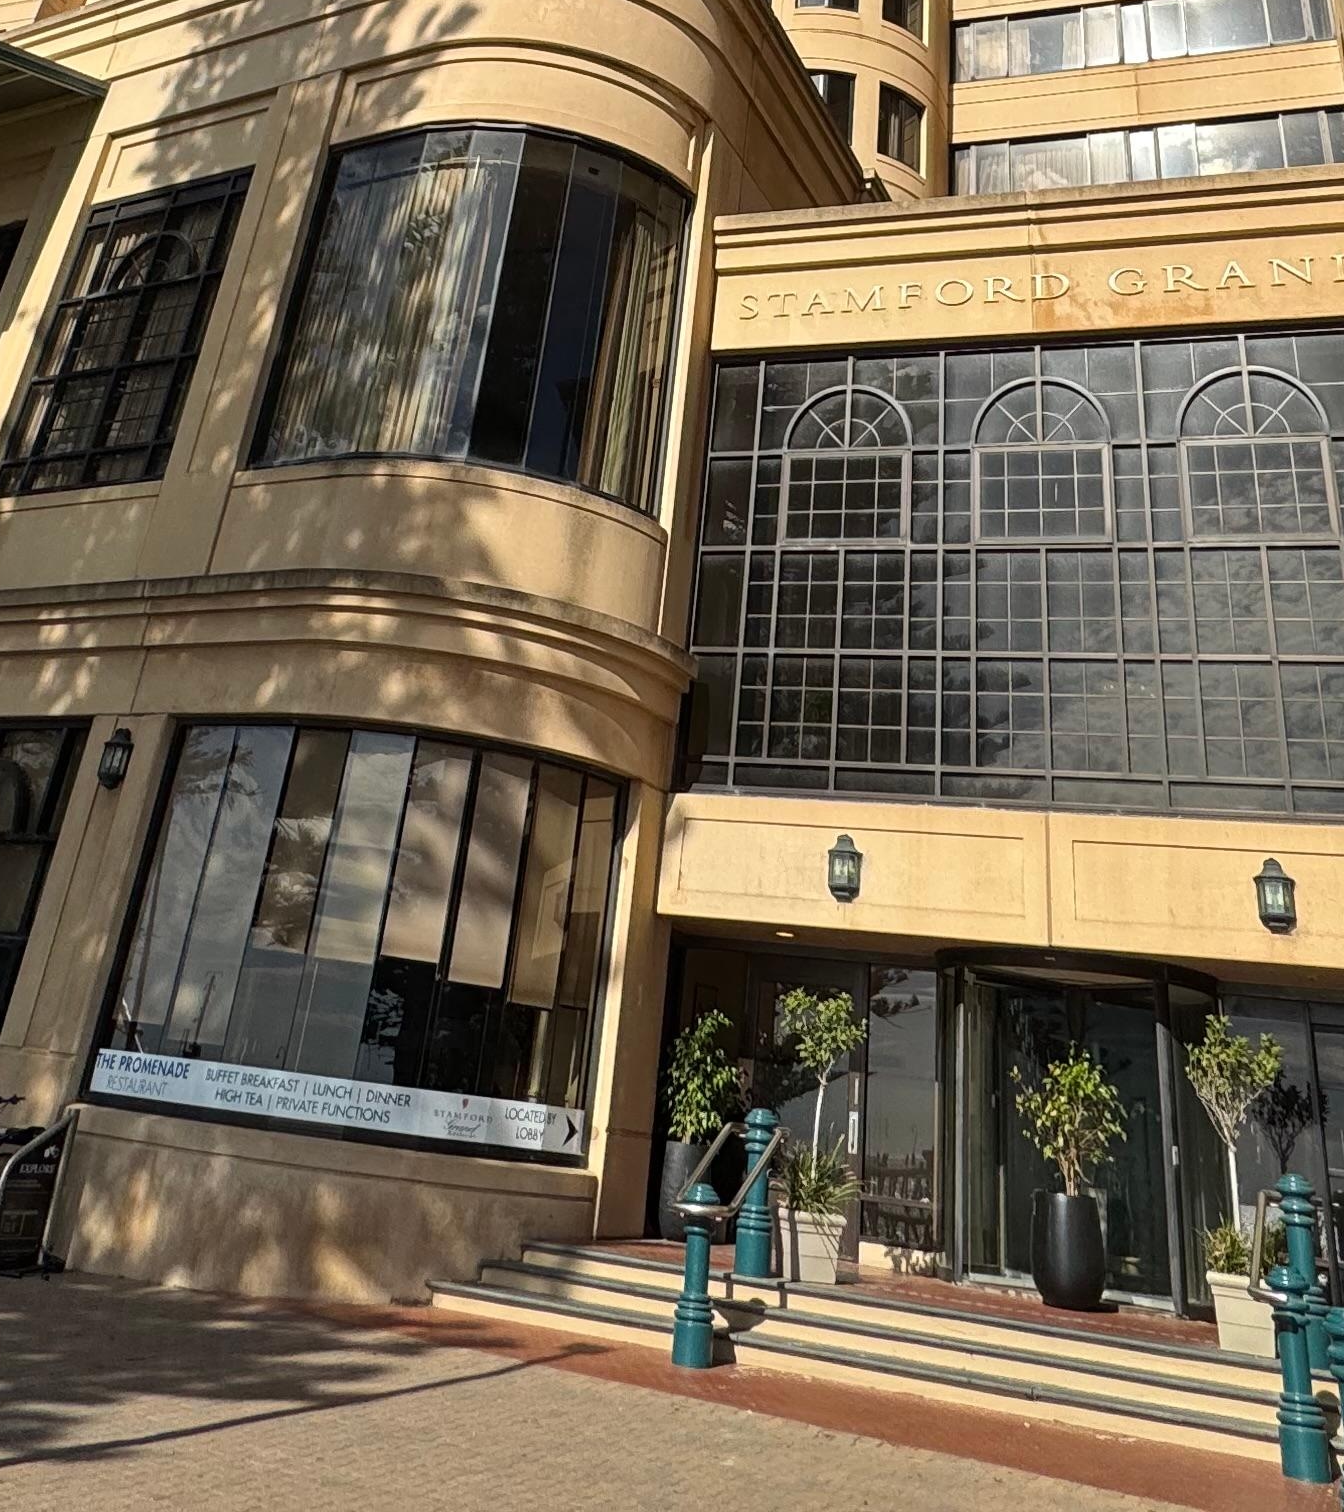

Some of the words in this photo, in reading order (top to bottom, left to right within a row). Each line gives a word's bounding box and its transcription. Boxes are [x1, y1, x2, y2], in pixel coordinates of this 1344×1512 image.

[738, 271, 1071, 321] STAMFORD
[96, 1052, 115, 1070] THE
[119, 1055, 191, 1080] PROMENADE
[106, 1074, 168, 1096] RESTAURANT
[205, 1068, 240, 1084] BUFFET
[240, 1072, 301, 1093] BREAKFAST
[312, 1082, 353, 1100] LUNCH
[365, 1089, 411, 1108] DINNER
[214, 1089, 242, 1104] HIGH
[244, 1091, 264, 1106] TEA
[276, 1095, 318, 1114] PRIVATE
[321, 1102, 391, 1124] FUNCTIONS
[434, 1108, 494, 1125] STAMFORD
[505, 1107, 546, 1124] LOCATED
[546, 1112, 558, 1125] BY
[515, 1127, 544, 1141] LOBBY
[19, 1163, 57, 1175] EXPLORE
